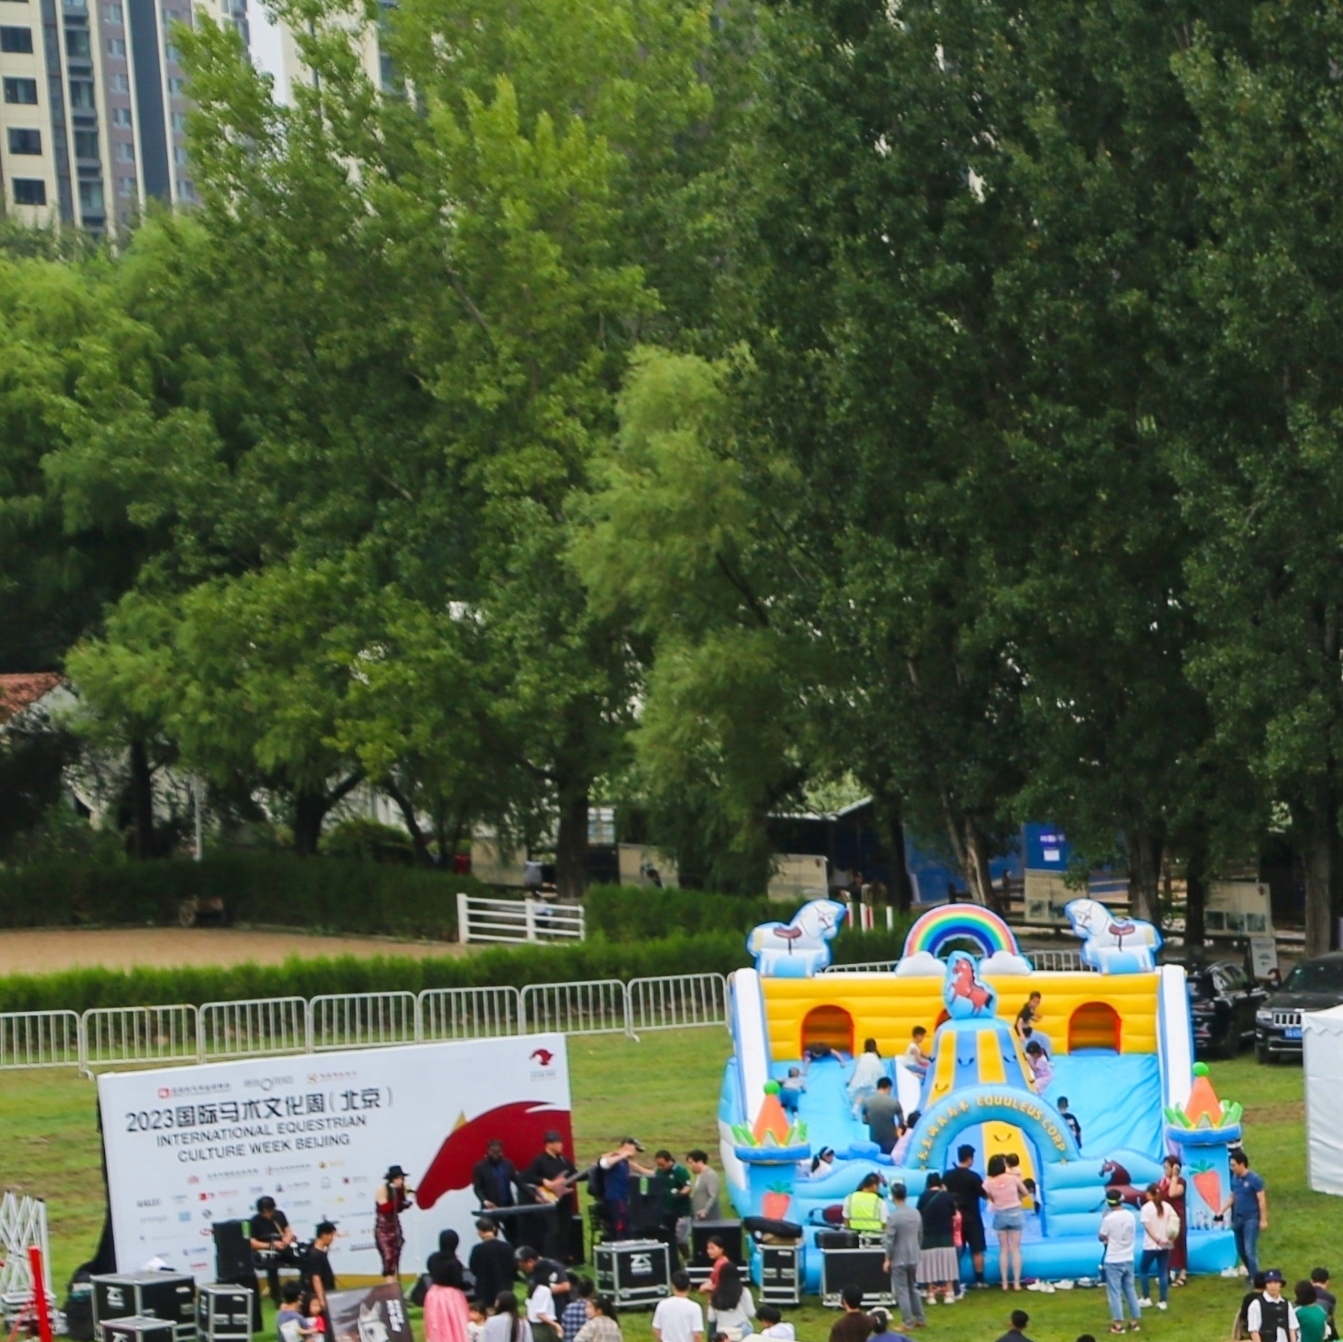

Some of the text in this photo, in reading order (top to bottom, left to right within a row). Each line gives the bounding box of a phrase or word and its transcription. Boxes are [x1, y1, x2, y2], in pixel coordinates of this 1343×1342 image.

[976, 1095, 1043, 1120] EQUULEUS
[157, 1115, 367, 1147] INTERNATIONAL EQUESTRIAN
[178, 1133, 350, 1162] CULTURE WEEK BEIJING
